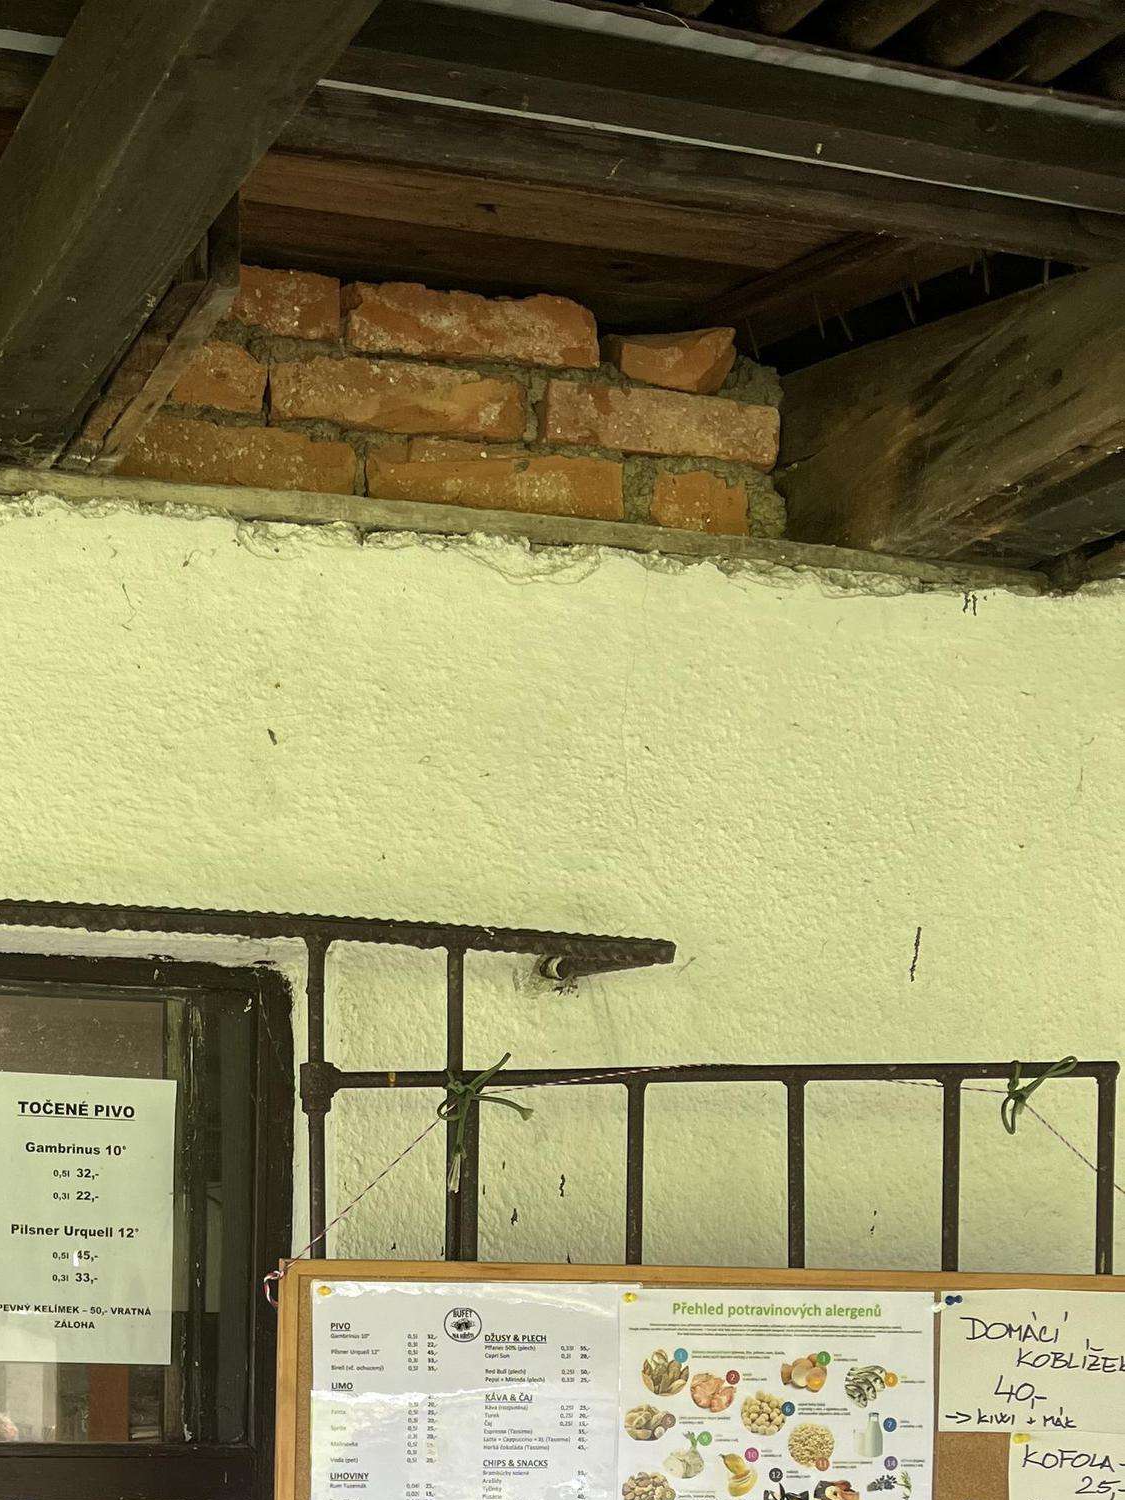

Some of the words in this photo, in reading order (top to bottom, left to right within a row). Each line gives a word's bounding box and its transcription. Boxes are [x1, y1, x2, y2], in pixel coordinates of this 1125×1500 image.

[18, 1099, 89, 1116] TOČENÉ
[95, 1105, 135, 1118] PIVO
[25, 1142, 101, 1155] Gambrinus
[106, 1145, 127, 1156] 10°
[76, 1169, 99, 1180] 32,-
[76, 1191, 99, 1202] 22,-
[11, 1224, 59, 1236] Pilsner
[64, 1226, 113, 1240] Urquell
[119, 1228, 139, 1238] 12°
[75, 1273, 98, 1284] 33,-
[34, 1304, 79, 1314] KELÍMEK
[90, 1307, 108, 1316] 50,-
[111, 1307, 151, 1316] VRATNÁ
[453, 1310, 473, 1318] BUFET
[673, 1302, 723, 1315] Přehled
[728, 1304, 821, 1319] potravinových
[825, 1304, 881, 1320] alergenů
[54, 1320, 95, 1329] ZÁLOHA
[960, 1311, 1068, 1343] DOMÁCÍ
[484, 1333, 511, 1342] DŽUSY
[485, 1393, 507, 1401] KÁVA
[519, 1393, 532, 1401] ČAJ
[994, 1375, 1047, 1409] 40,-
[746, 1450, 757, 1459] 10
[1022, 1445, 1115, 1469] KOFOLA
[886, 1459, 896, 1468] 14
[771, 1471, 781, 1480] 12
